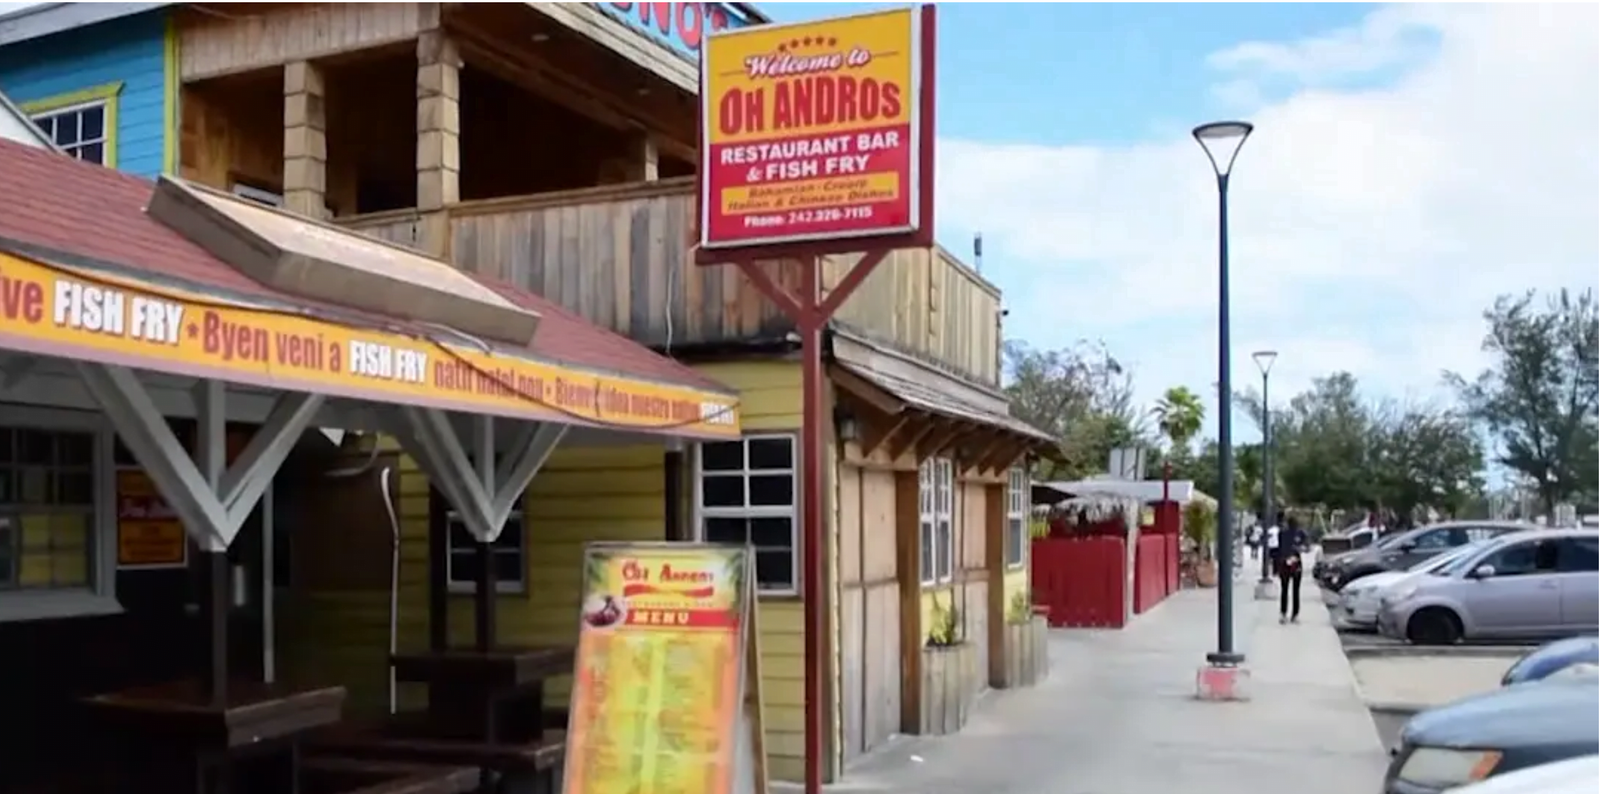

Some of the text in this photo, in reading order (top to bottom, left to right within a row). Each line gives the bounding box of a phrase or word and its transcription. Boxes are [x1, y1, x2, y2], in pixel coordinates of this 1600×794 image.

[744, 47, 871, 78] Welcome to
[719, 75, 901, 135] OH ANDROS
[721, 131, 899, 165] RESTAURANT BAR
[746, 154, 870, 182] & FISH FRY
[0, 276, 43, 323] ve
[54, 279, 124, 336] FISH
[131, 296, 185, 345] FRY
[203, 310, 270, 362] Byen
[276, 331, 324, 371] veni
[329, 342, 341, 372] a
[349, 339, 392, 380] FISH
[395, 348, 428, 384] FRY
[632, 611, 689, 624] MENU
